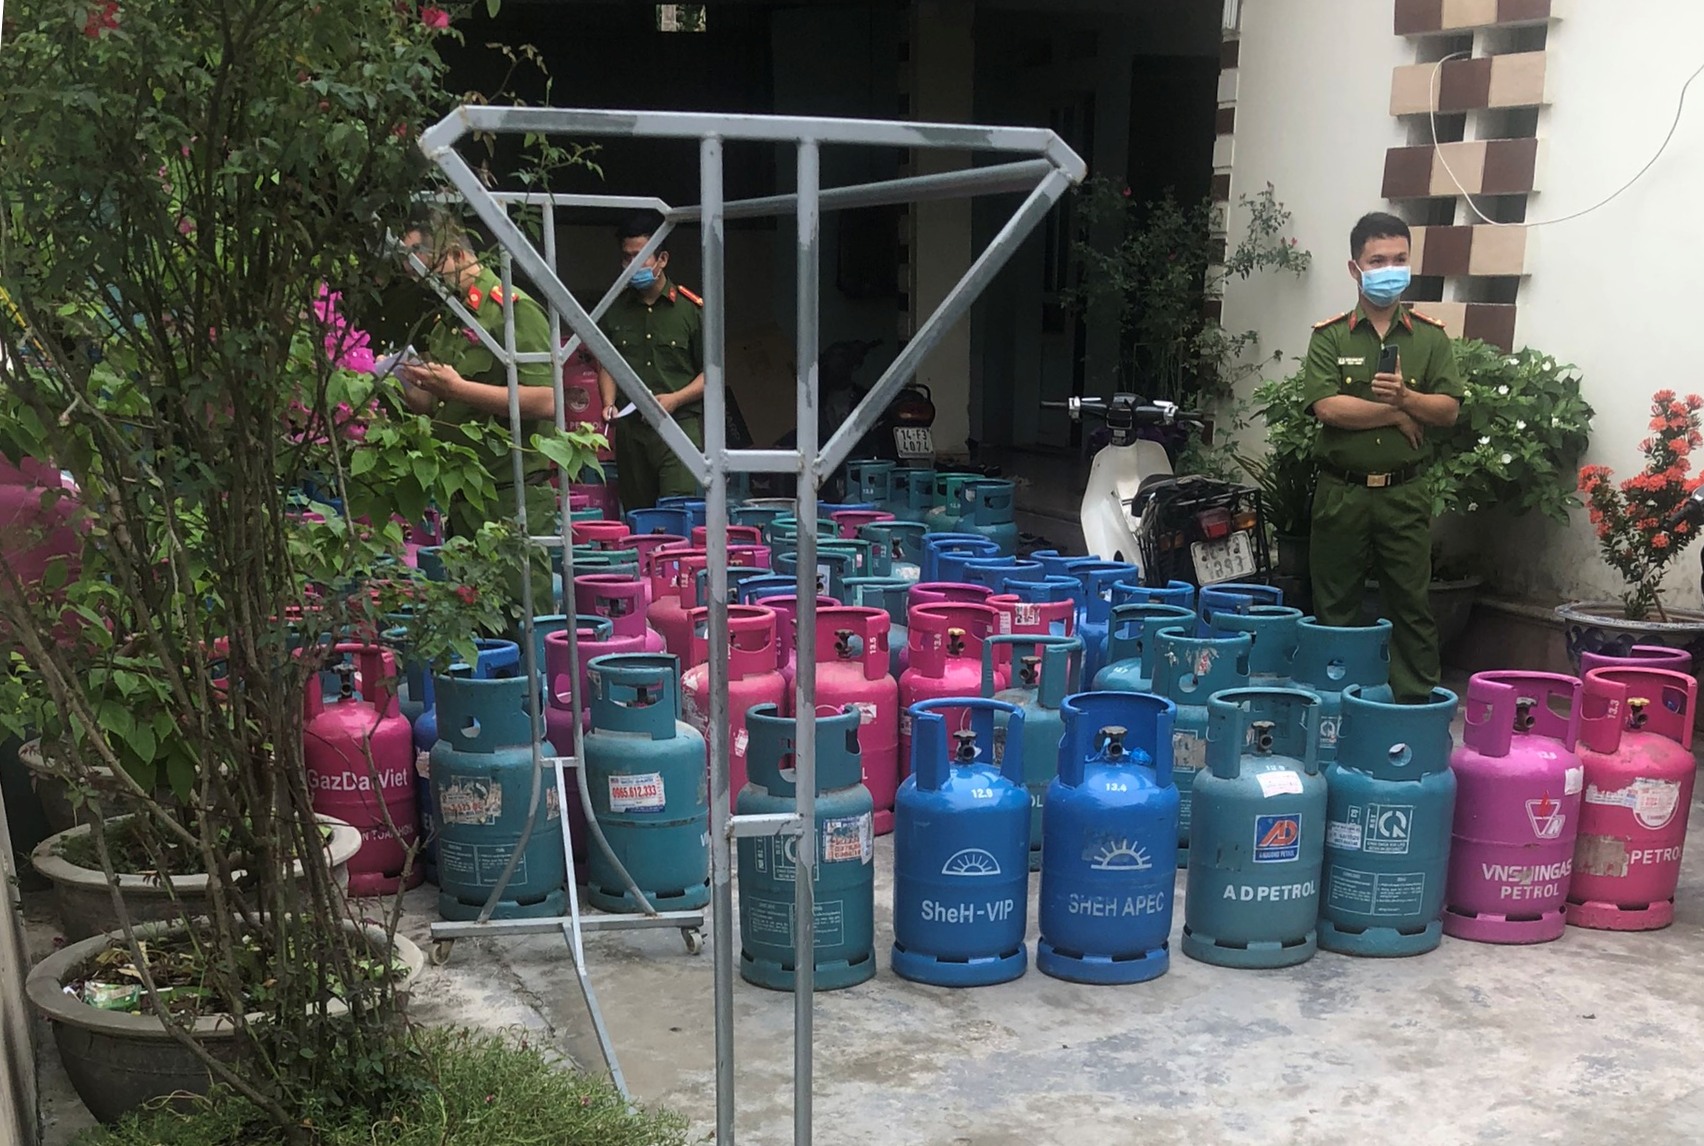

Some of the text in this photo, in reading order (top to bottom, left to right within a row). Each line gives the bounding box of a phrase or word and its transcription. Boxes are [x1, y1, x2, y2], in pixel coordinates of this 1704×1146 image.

[569, 421, 603, 430] PEOL
[903, 440, 929, 451] 4074
[869, 636, 877, 655] 13.5
[1607, 699, 1620, 720] 13.3
[971, 788, 993, 799] 12.9
[1105, 782, 1128, 793] 13.4
[1500, 883, 1559, 900] PETROL
[921, 899, 1014, 923] SheH-VIP
[1068, 891, 1165, 917] SHEH APEC
